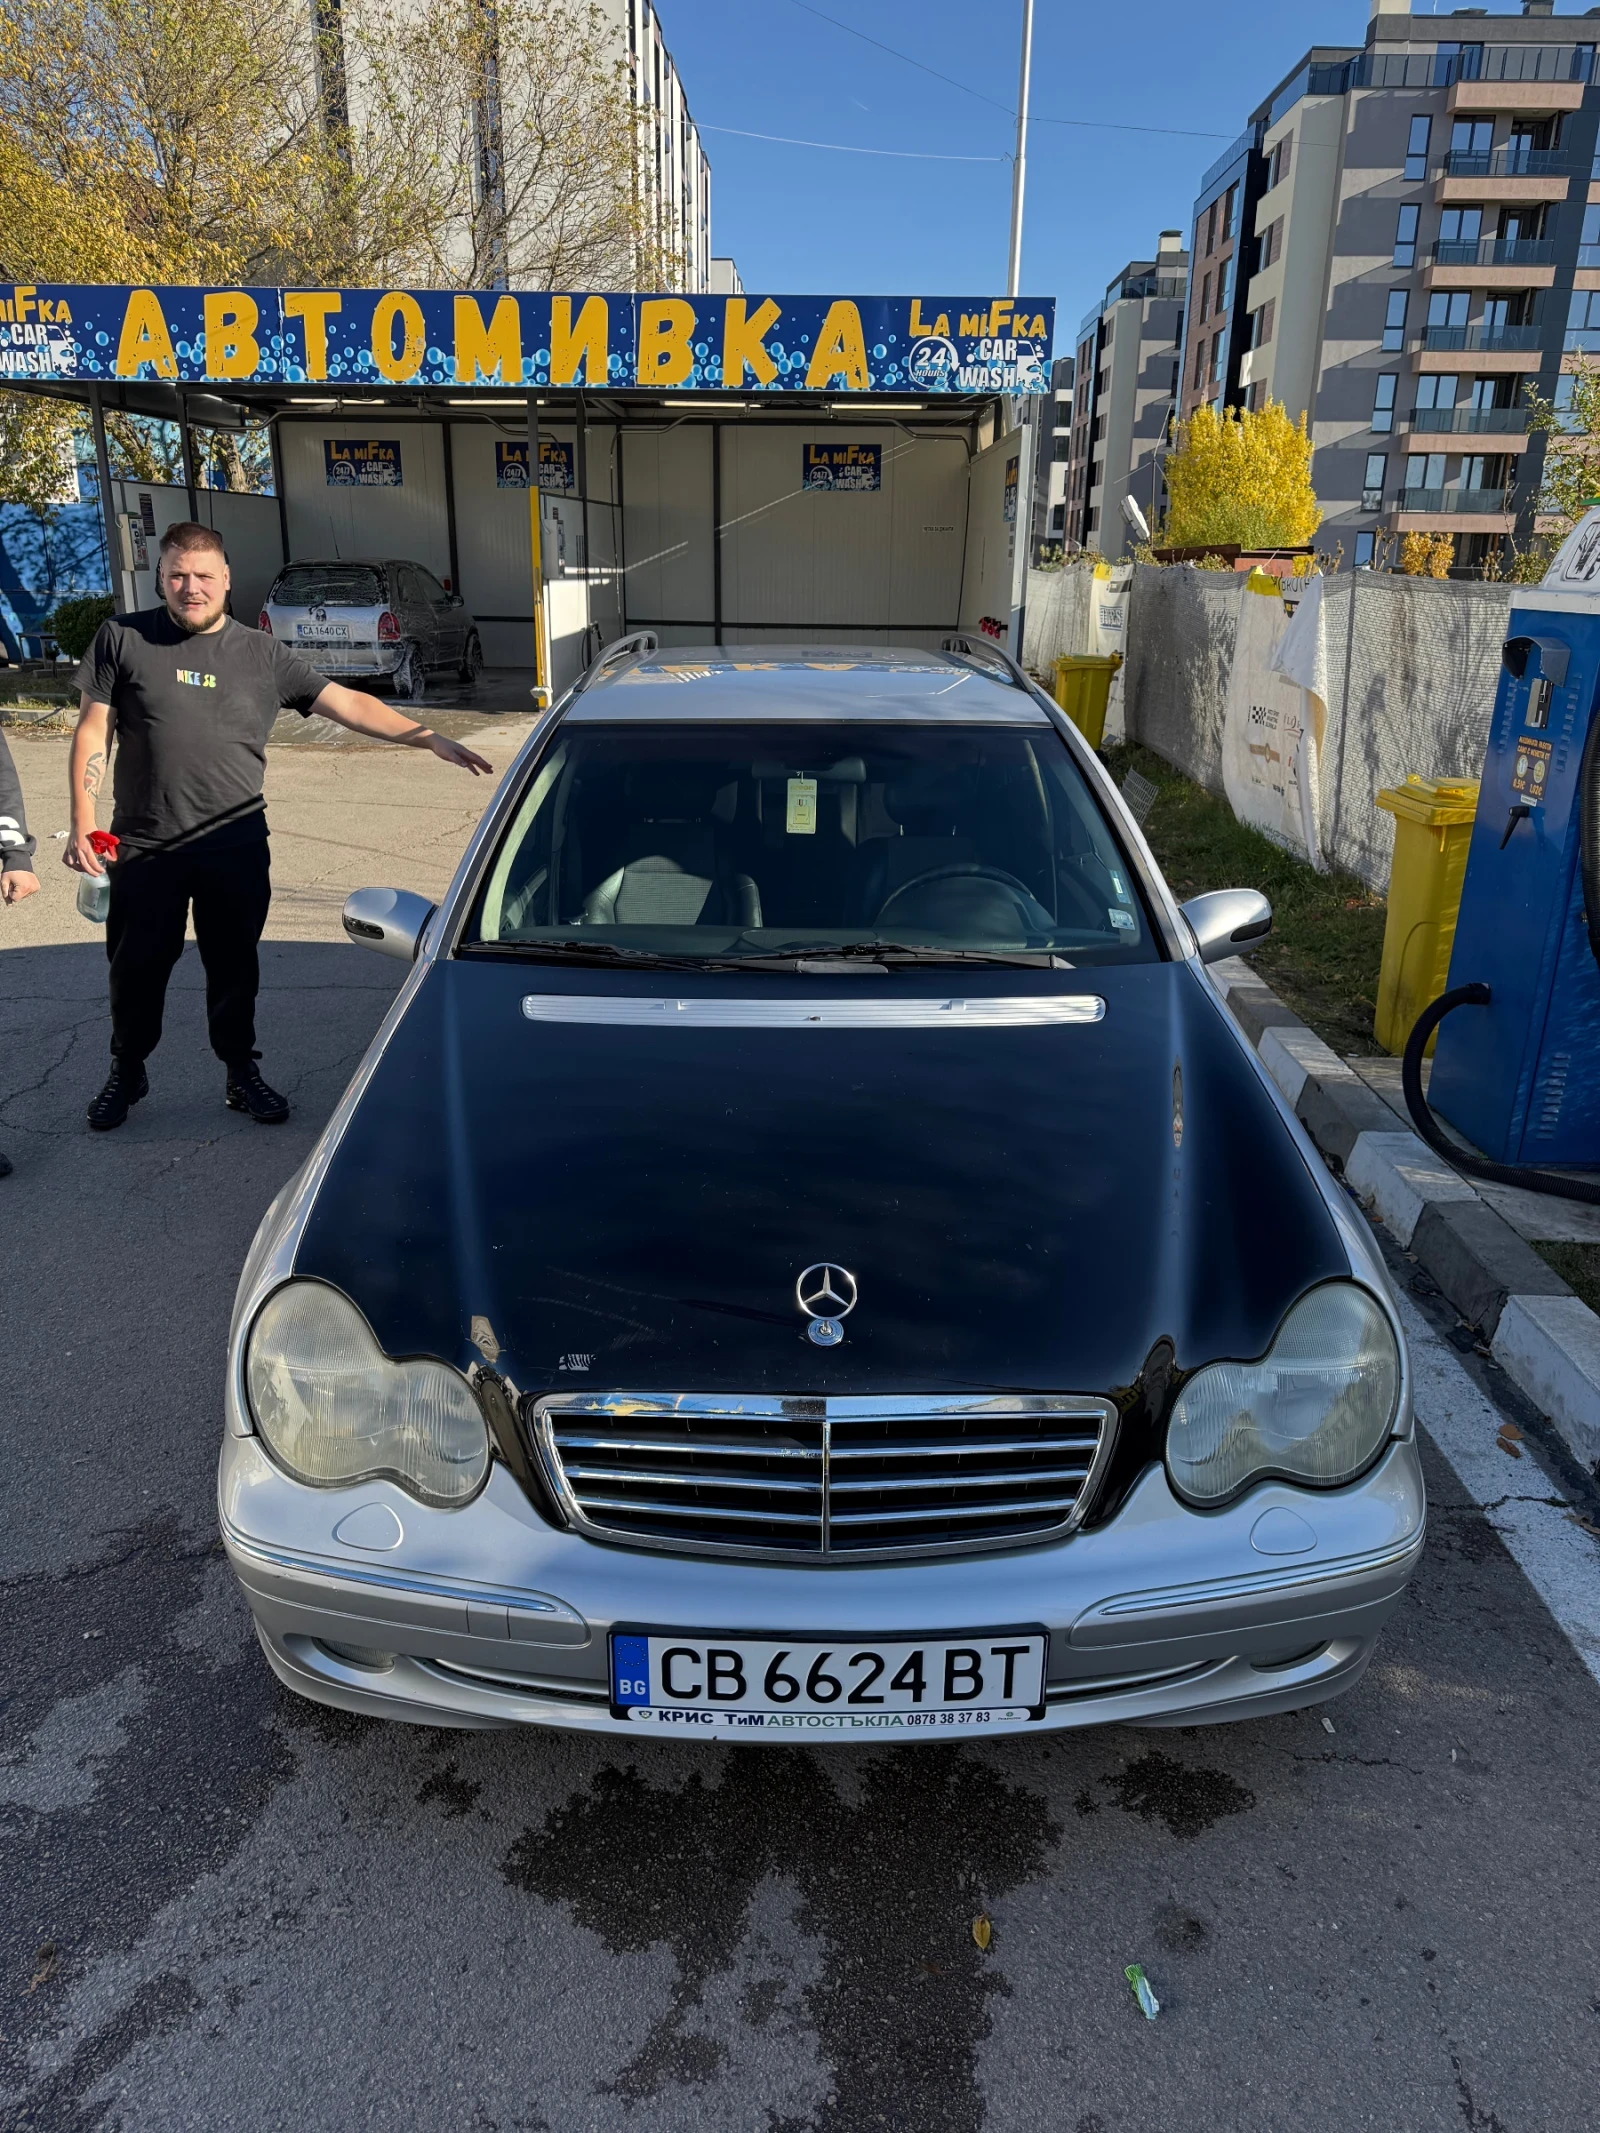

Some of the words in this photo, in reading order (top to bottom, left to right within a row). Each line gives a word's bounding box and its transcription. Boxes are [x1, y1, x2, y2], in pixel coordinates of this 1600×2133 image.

[11, 324, 48, 345] CAR
[115, 289, 871, 389] АВТОМИВКА
[915, 346, 947, 366] 24
[979, 339, 1017, 360] CAR
[915, 369, 945, 377] HOURS
[959, 366, 1016, 388] WASH
[367, 461, 383, 472] CAR
[539, 463, 555, 474] CAR
[844, 466, 861, 476] CAR
[359, 474, 384, 484] WASH
[539, 477, 556, 486] ASH
[836, 479, 862, 489] WASH
[763, 1649, 927, 1704] 6624
[618, 1679, 647, 1697] BG
[658, 1710, 714, 1724] КРИС
[767, 1715, 904, 1728] АВТОСТЪКЛА
[907, 1712, 936, 1725] 0878
[940, 1713, 954, 1724] 38
[958, 1712, 973, 1723] 37
[976, 1711, 991, 1723] 83
